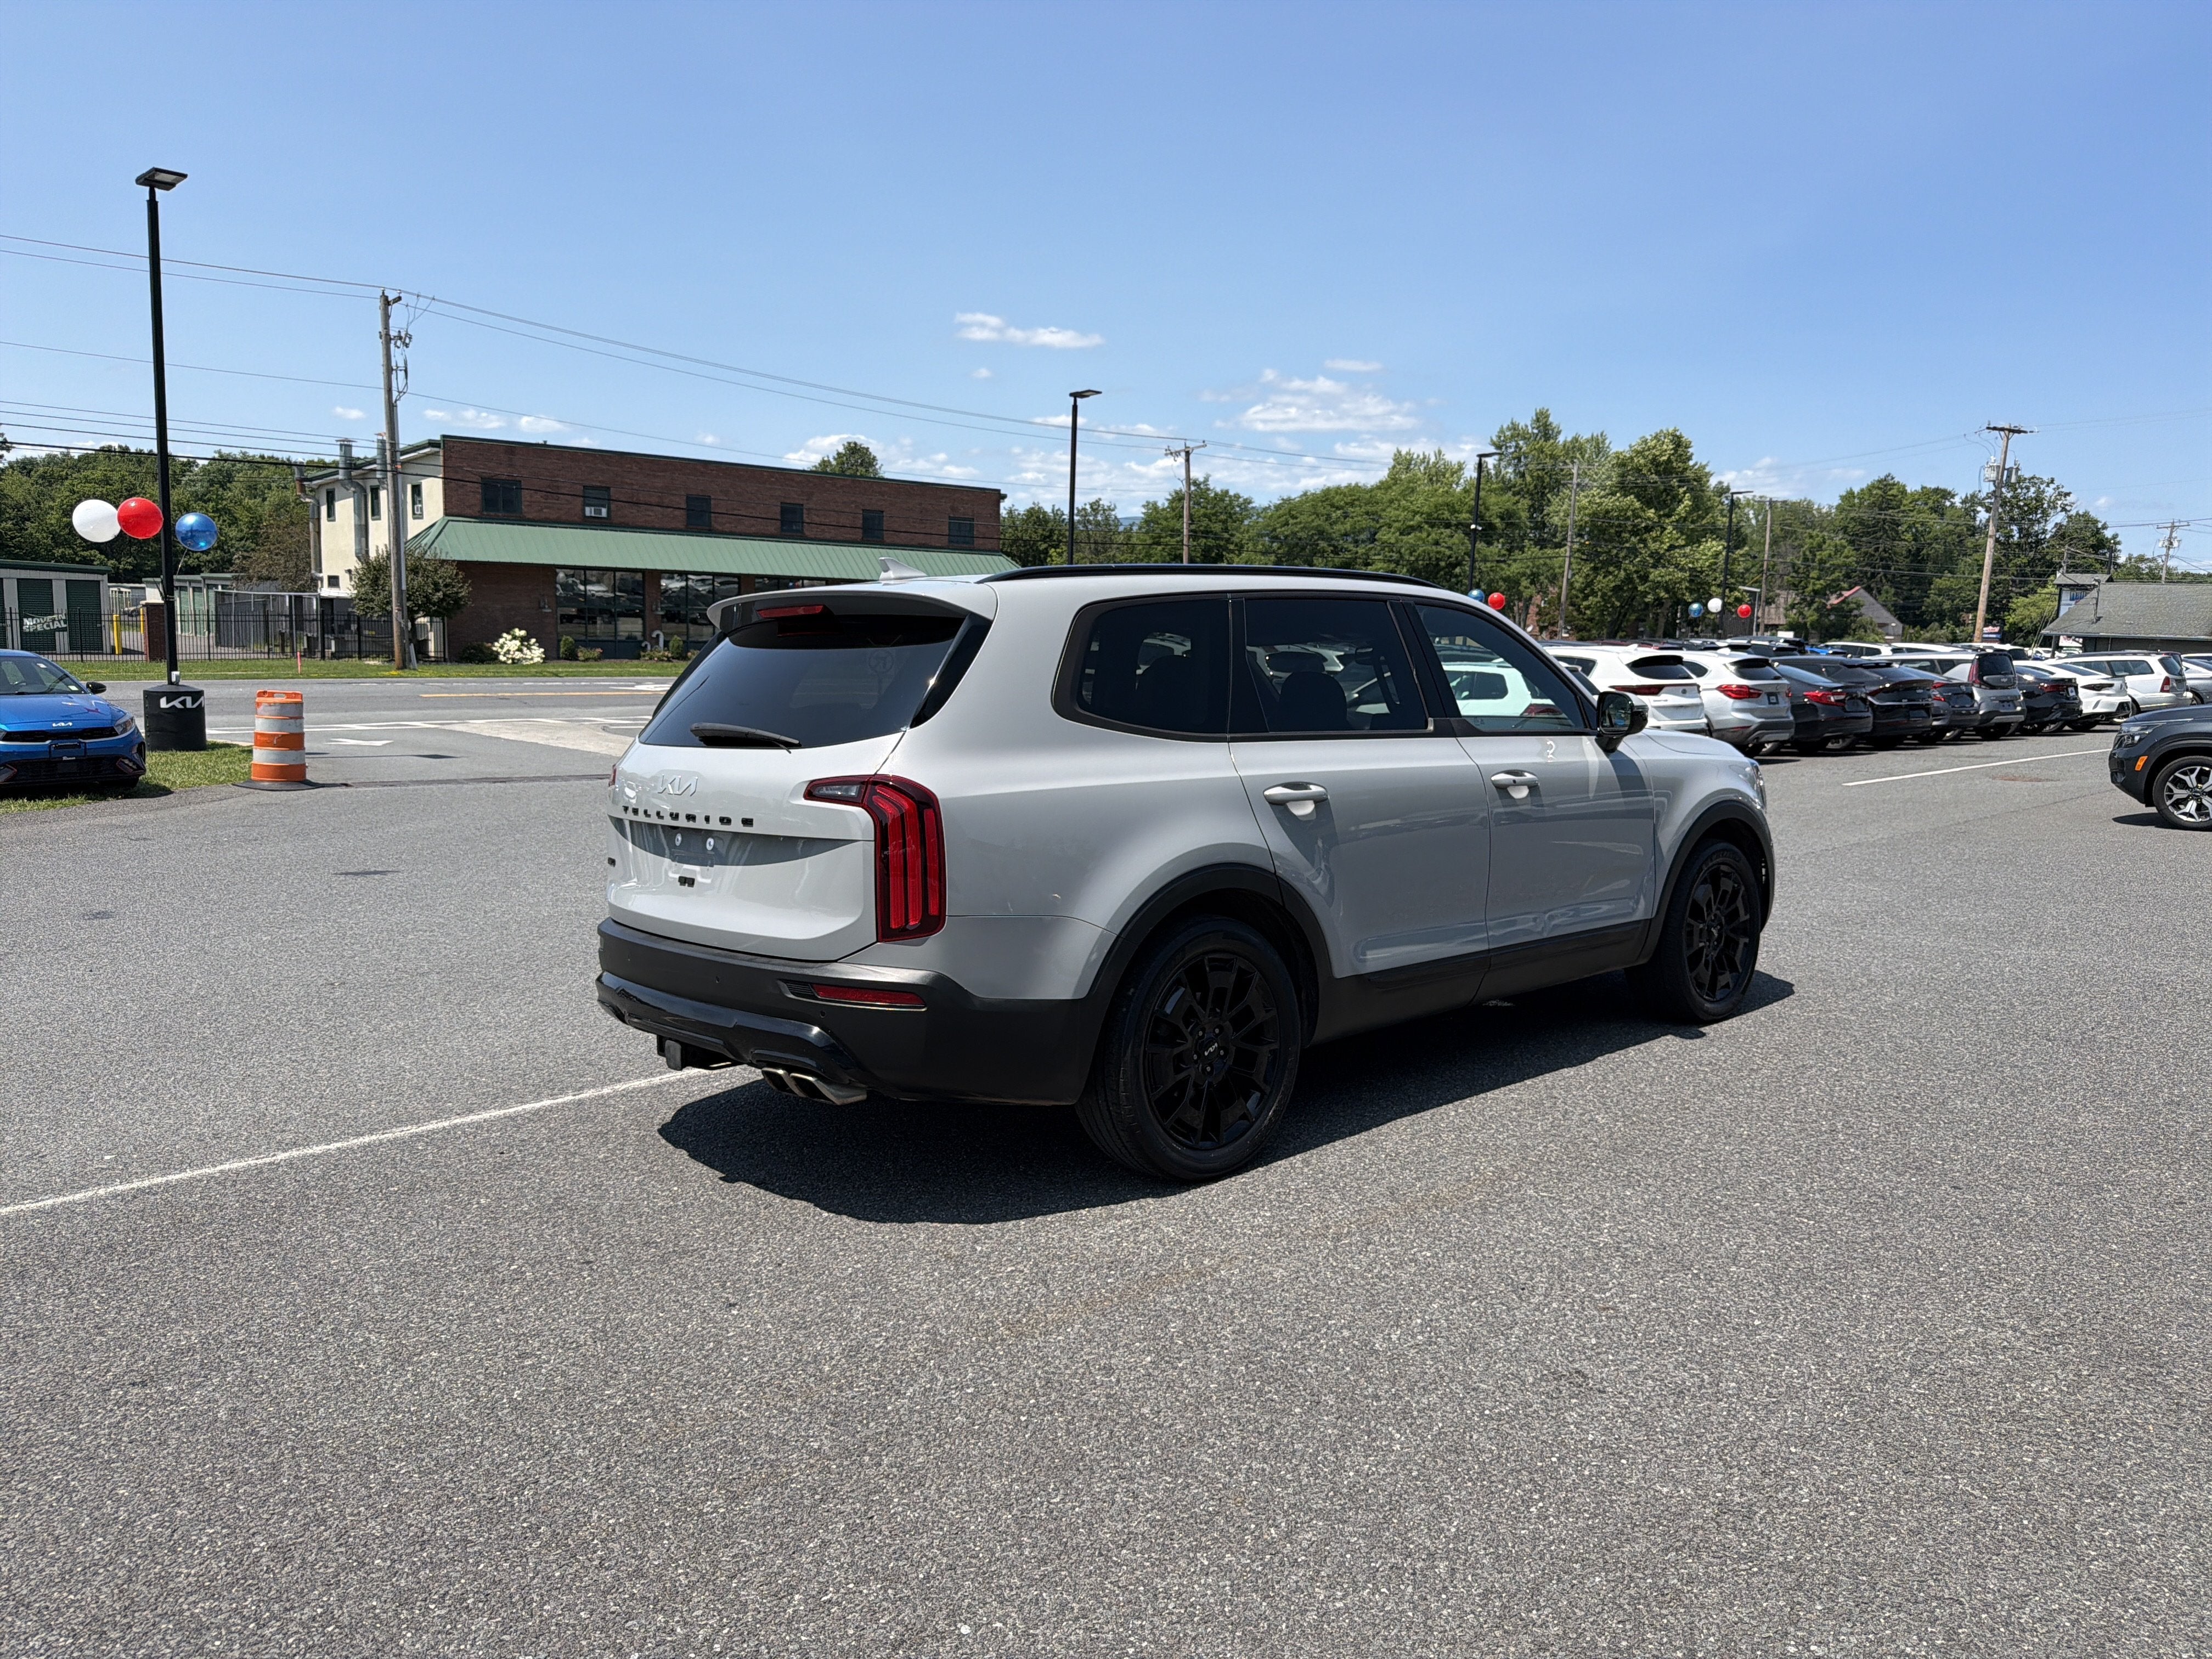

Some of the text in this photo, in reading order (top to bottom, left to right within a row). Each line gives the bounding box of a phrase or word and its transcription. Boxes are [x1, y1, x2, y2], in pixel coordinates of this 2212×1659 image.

[23, 613, 66, 625] MOVE-IN
[22, 620, 67, 632] SPECIAL
[160, 696, 204, 708] KIA
[657, 774, 699, 796] KIA
[622, 805, 754, 827] TELLURIDE
